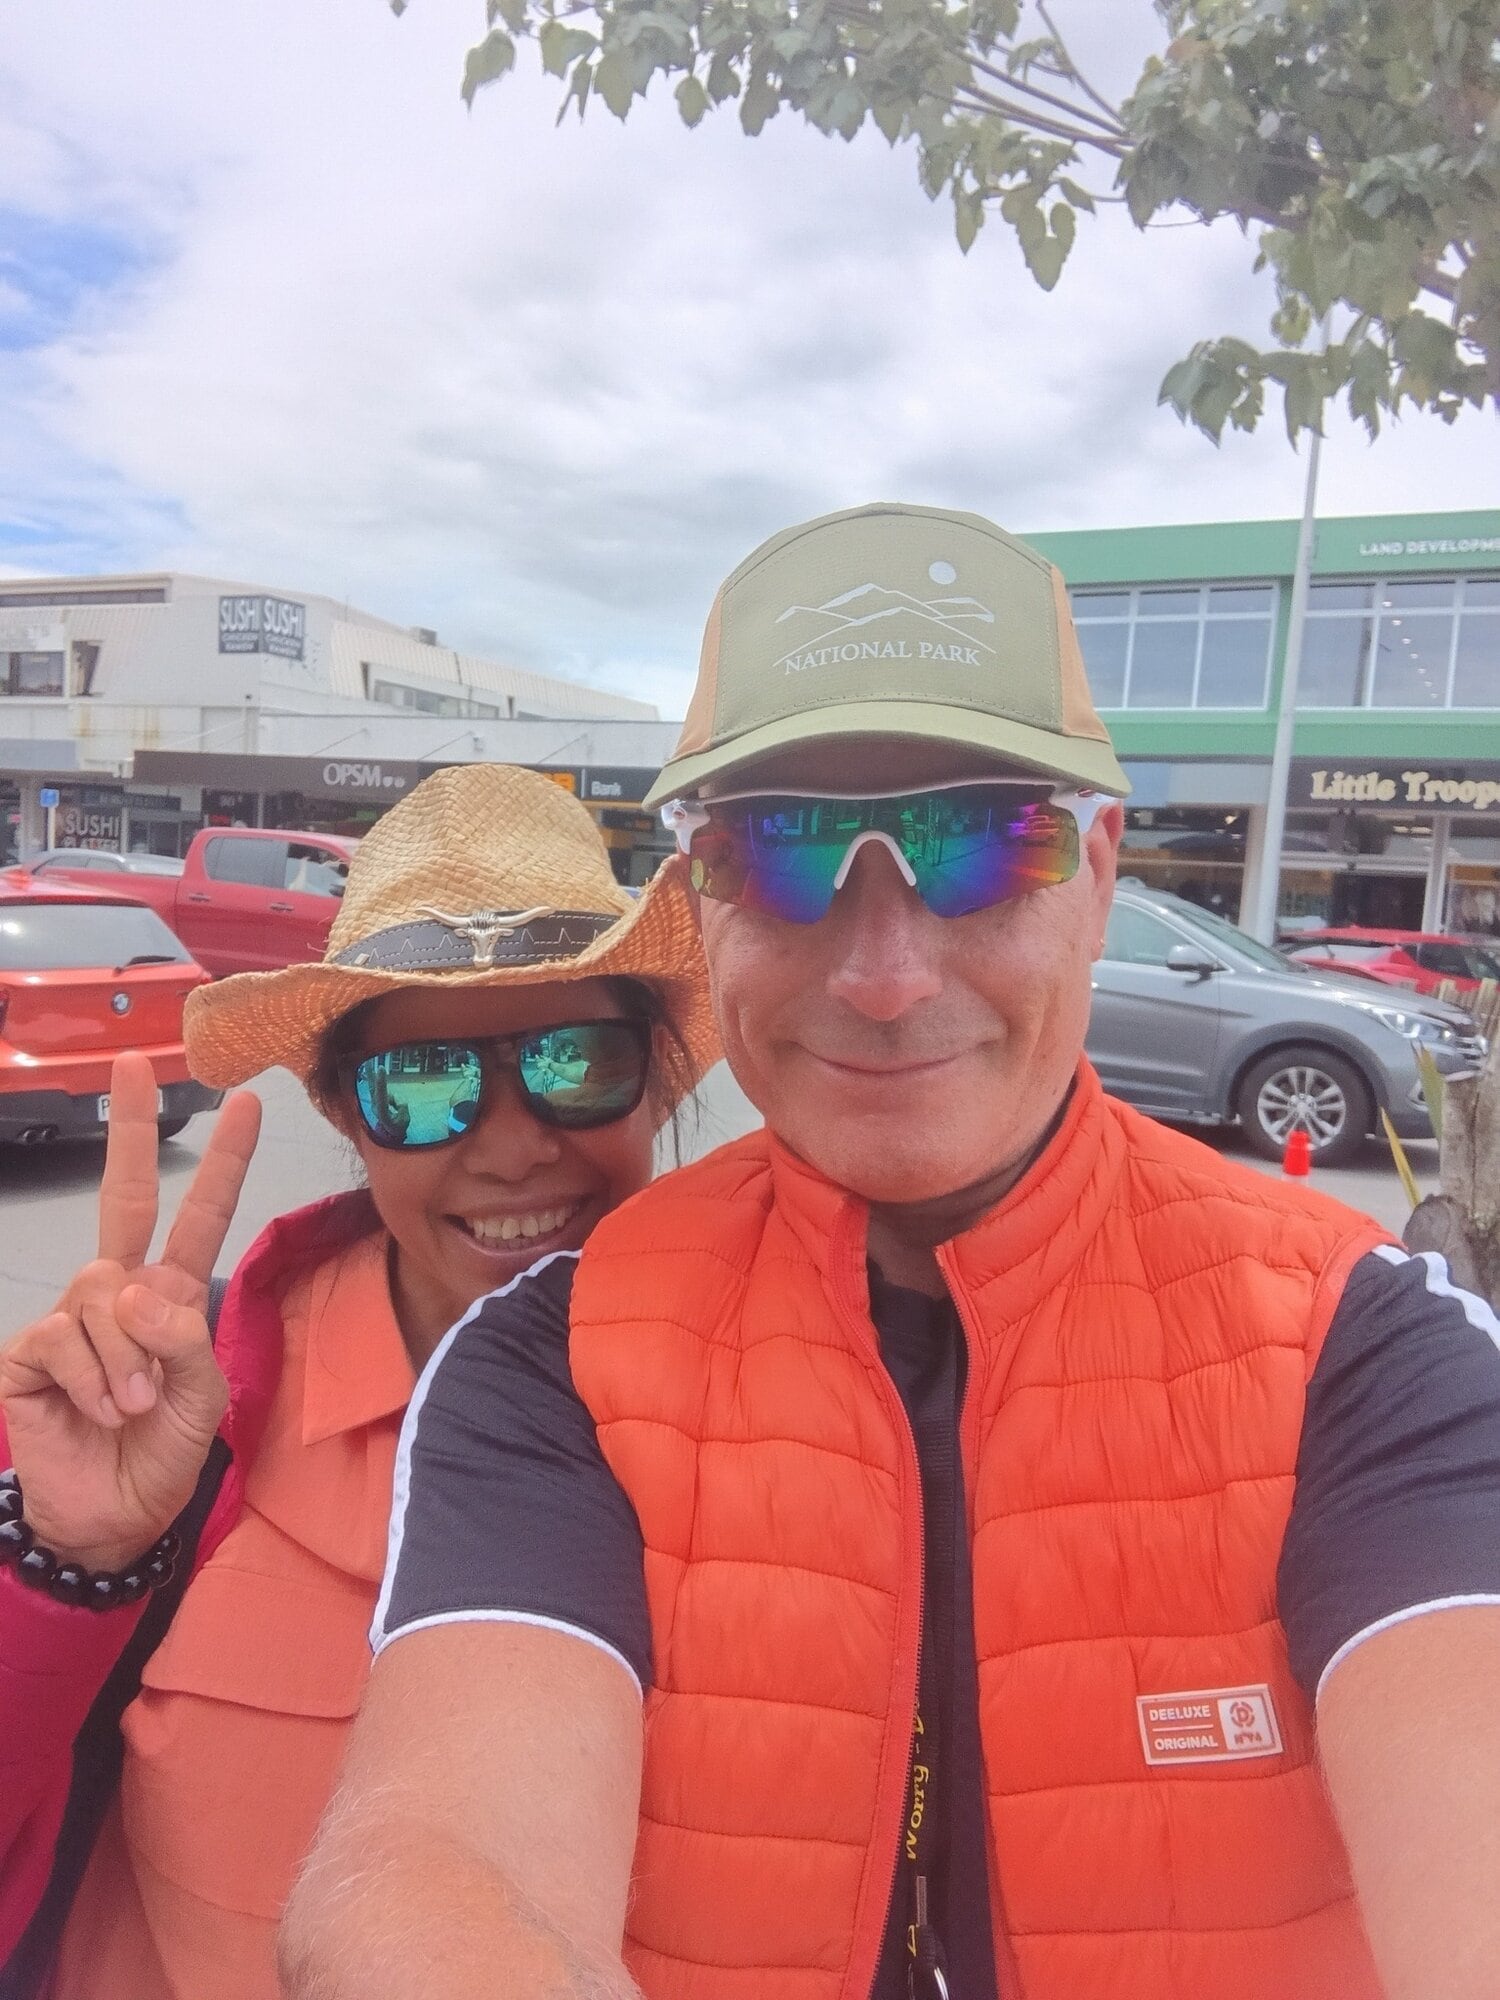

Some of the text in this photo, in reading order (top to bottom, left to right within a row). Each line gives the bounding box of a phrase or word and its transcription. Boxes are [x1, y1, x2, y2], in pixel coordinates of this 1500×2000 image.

[1359, 541, 1404, 556] LAND
[220, 598, 259, 632] SUSHI
[263, 598, 303, 639] SUSHI
[784, 641, 981, 675] NATIONAL PARK
[322, 763, 381, 788] OPSM
[1310, 770, 1396, 802] Little
[591, 781, 622, 797] Bank
[64, 813, 120, 838] SUSHI
[1150, 1705, 1211, 1721] DEELUXE
[1154, 1735, 1219, 1751] ORIGINAL
